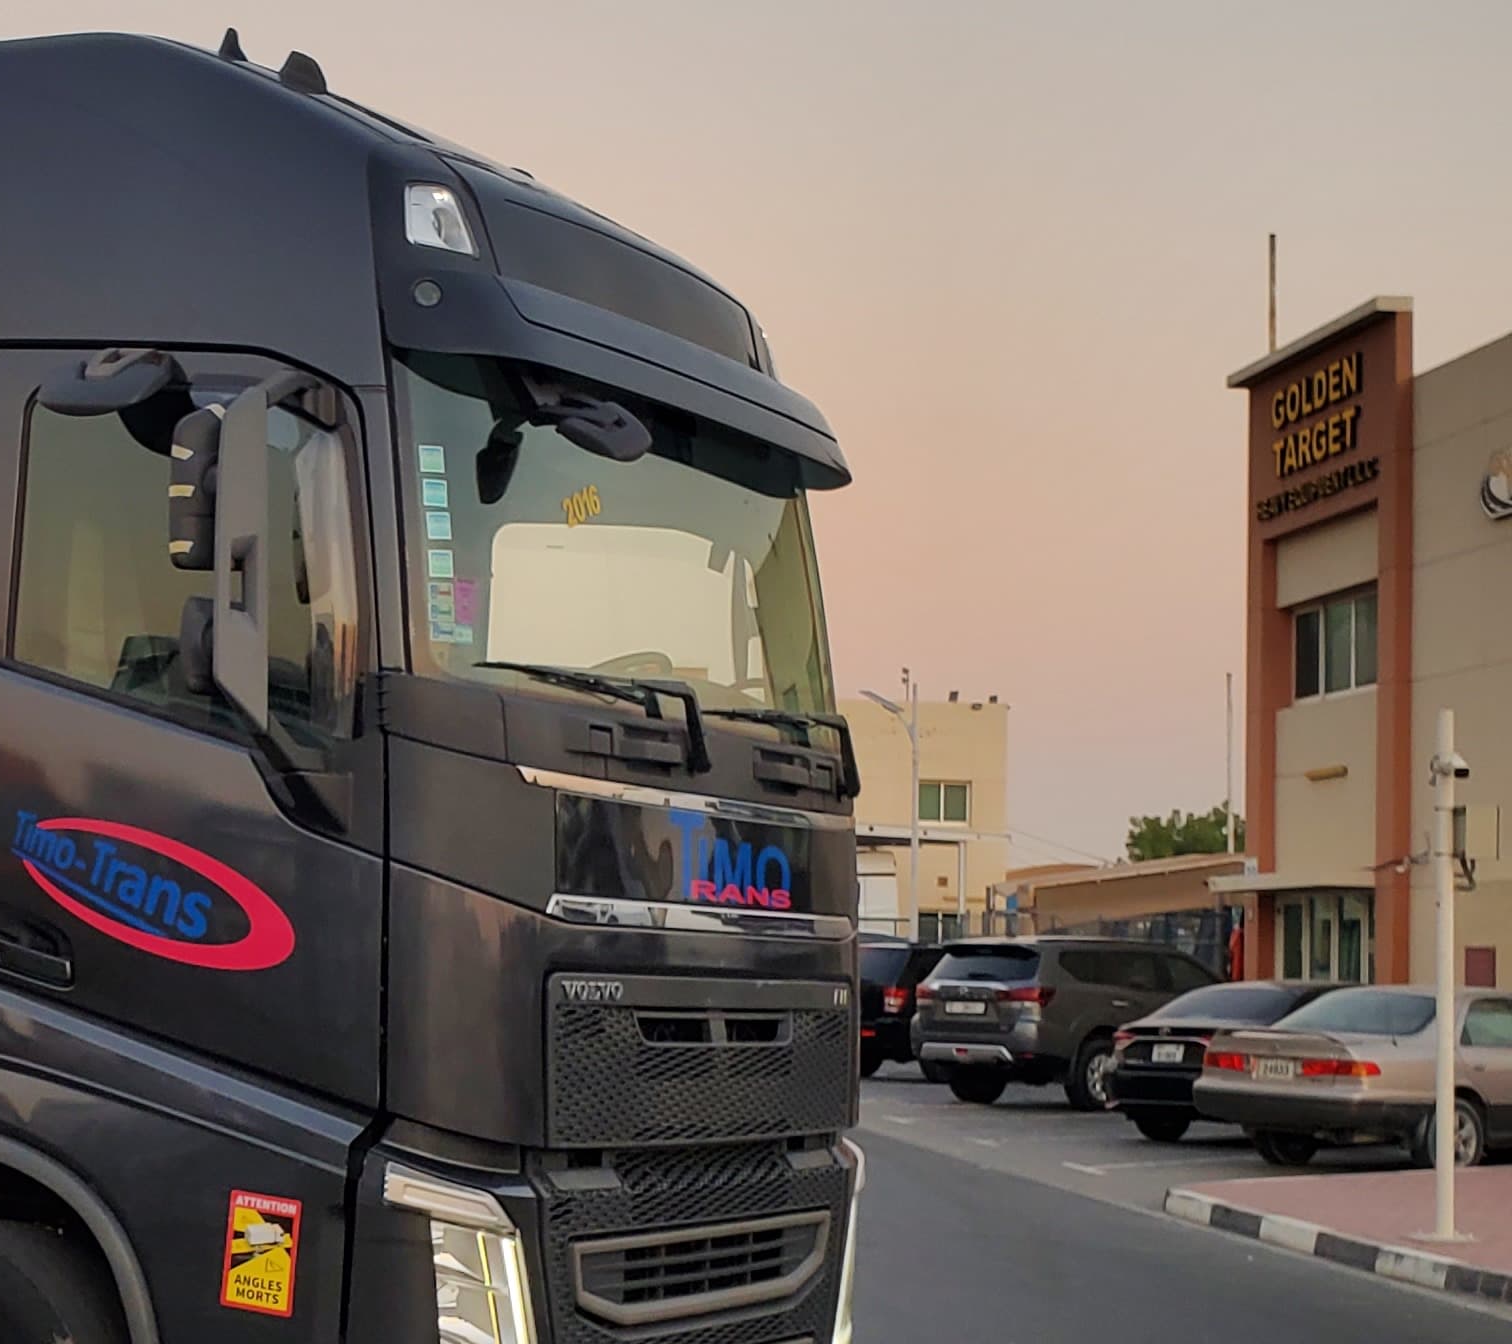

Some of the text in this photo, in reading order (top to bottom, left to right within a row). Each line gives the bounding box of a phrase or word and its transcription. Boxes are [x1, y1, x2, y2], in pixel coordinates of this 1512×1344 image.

[1272, 353, 1358, 429] GOLDEN
[1272, 406, 1357, 476] TARGET
[562, 483, 601, 528] 2016
[690, 879, 792, 910] RANS
[561, 980, 624, 1002] VOLVO
[235, 1194, 298, 1216] ATTENTION
[234, 1273, 283, 1293] ANGLES
[235, 1287, 280, 1305] MORTS
